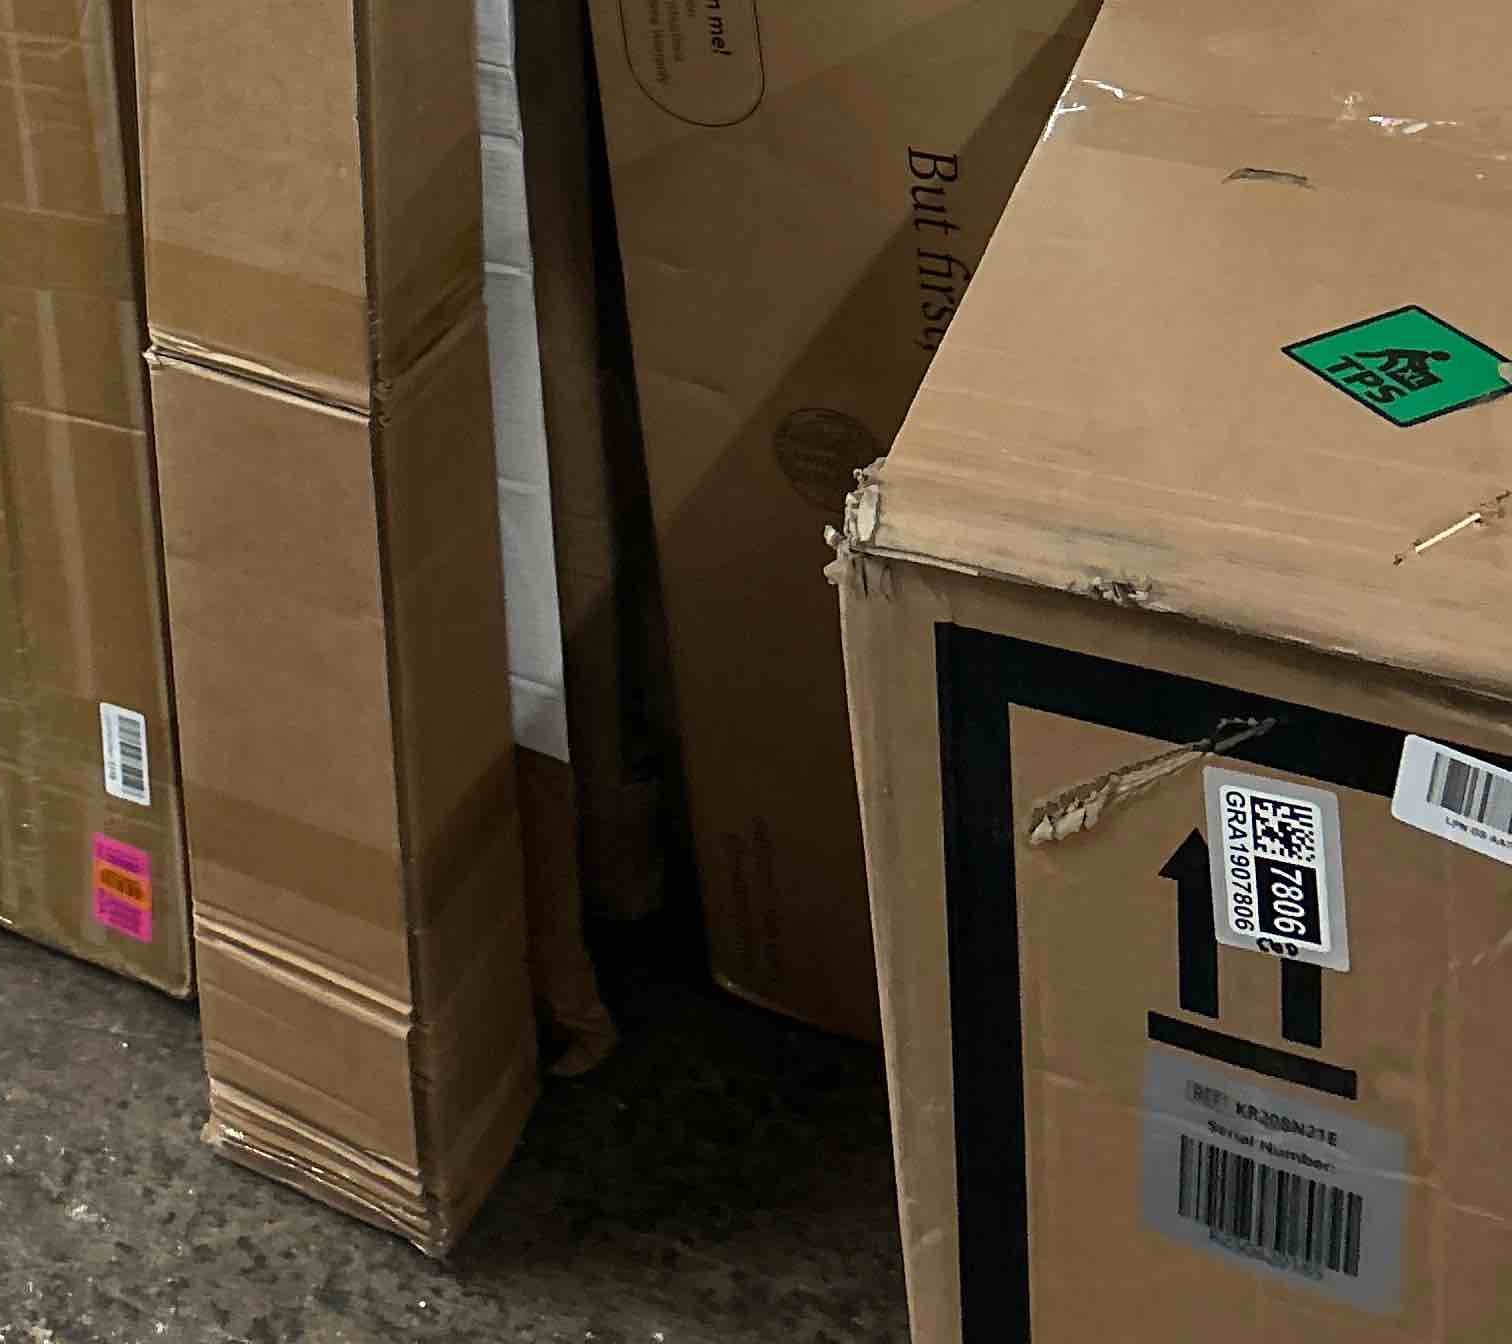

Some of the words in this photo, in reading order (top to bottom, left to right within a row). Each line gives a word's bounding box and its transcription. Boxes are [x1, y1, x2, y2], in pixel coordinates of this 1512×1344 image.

[707, 22, 733, 58] me!
[907, 145, 961, 236] But
[1327, 353, 1409, 404] TPS
[1225, 790, 1255, 933] GRA1907806
[1270, 865, 1306, 934] 7806
[1207, 1119, 1254, 1147] Serial
